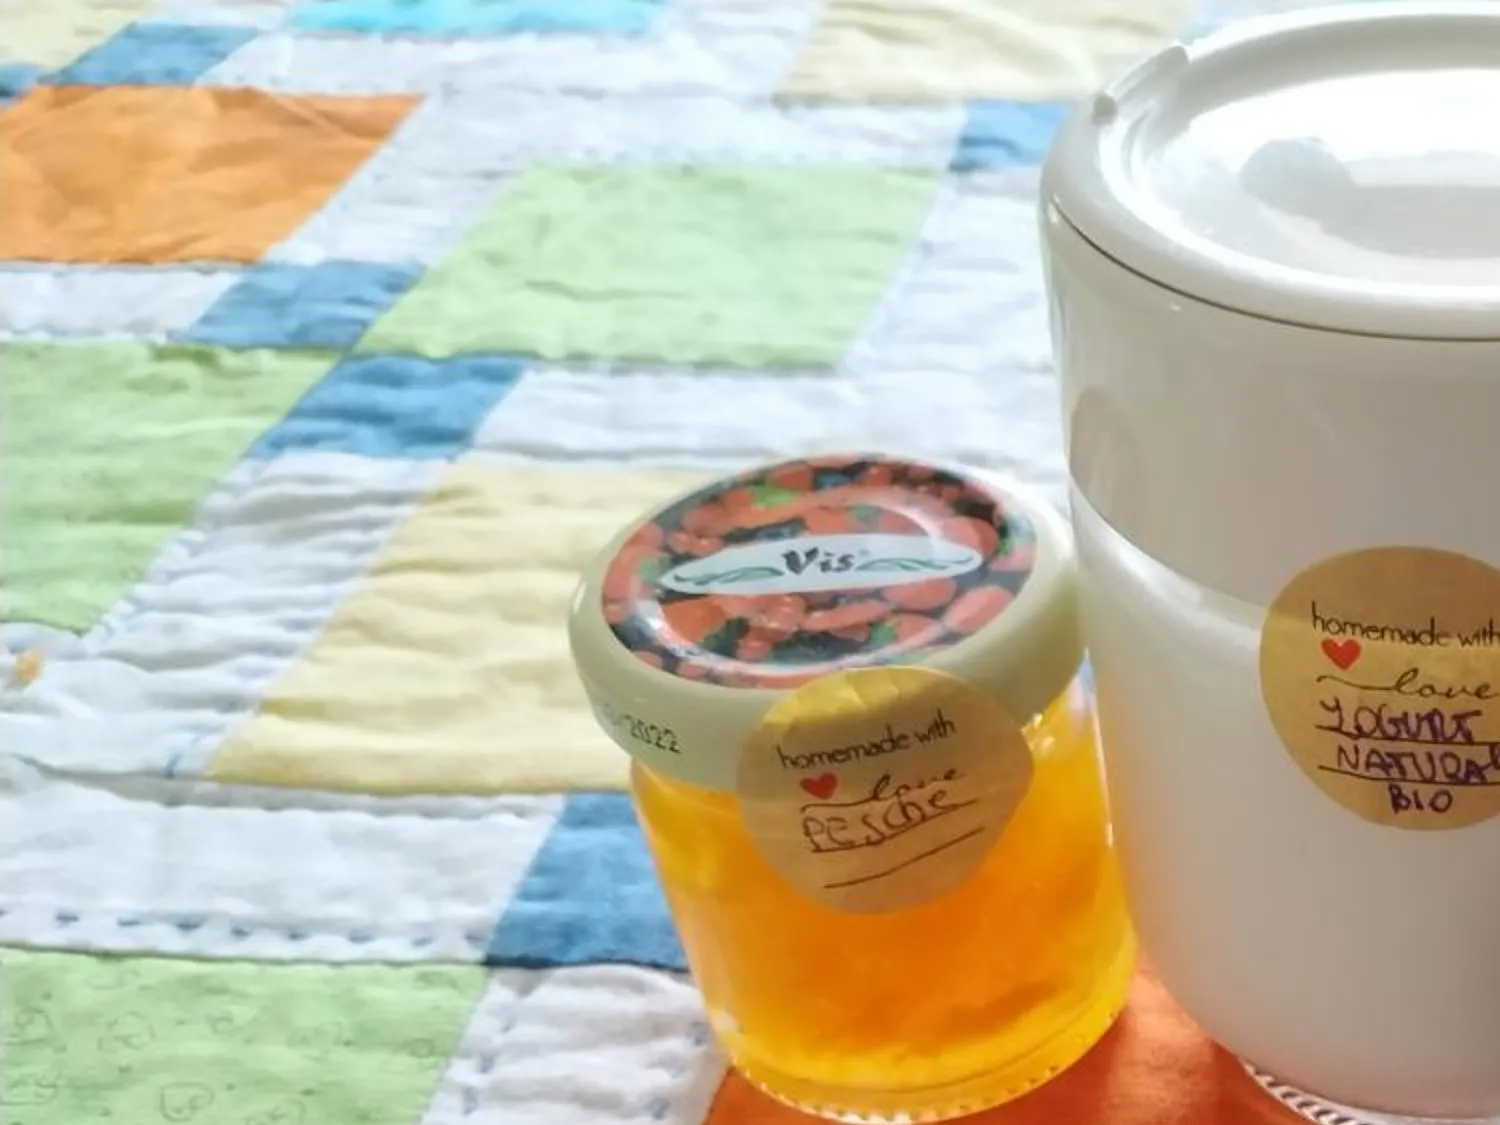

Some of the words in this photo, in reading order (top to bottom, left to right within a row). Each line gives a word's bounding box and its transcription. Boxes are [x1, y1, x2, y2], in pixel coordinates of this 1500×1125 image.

[781, 546, 855, 576] Vis
[1310, 600, 1451, 648] homemade
[1390, 667, 1500, 700] love
[775, 722, 910, 769] homemade
[914, 707, 957, 744] with
[1388, 782, 1454, 814] BIO
